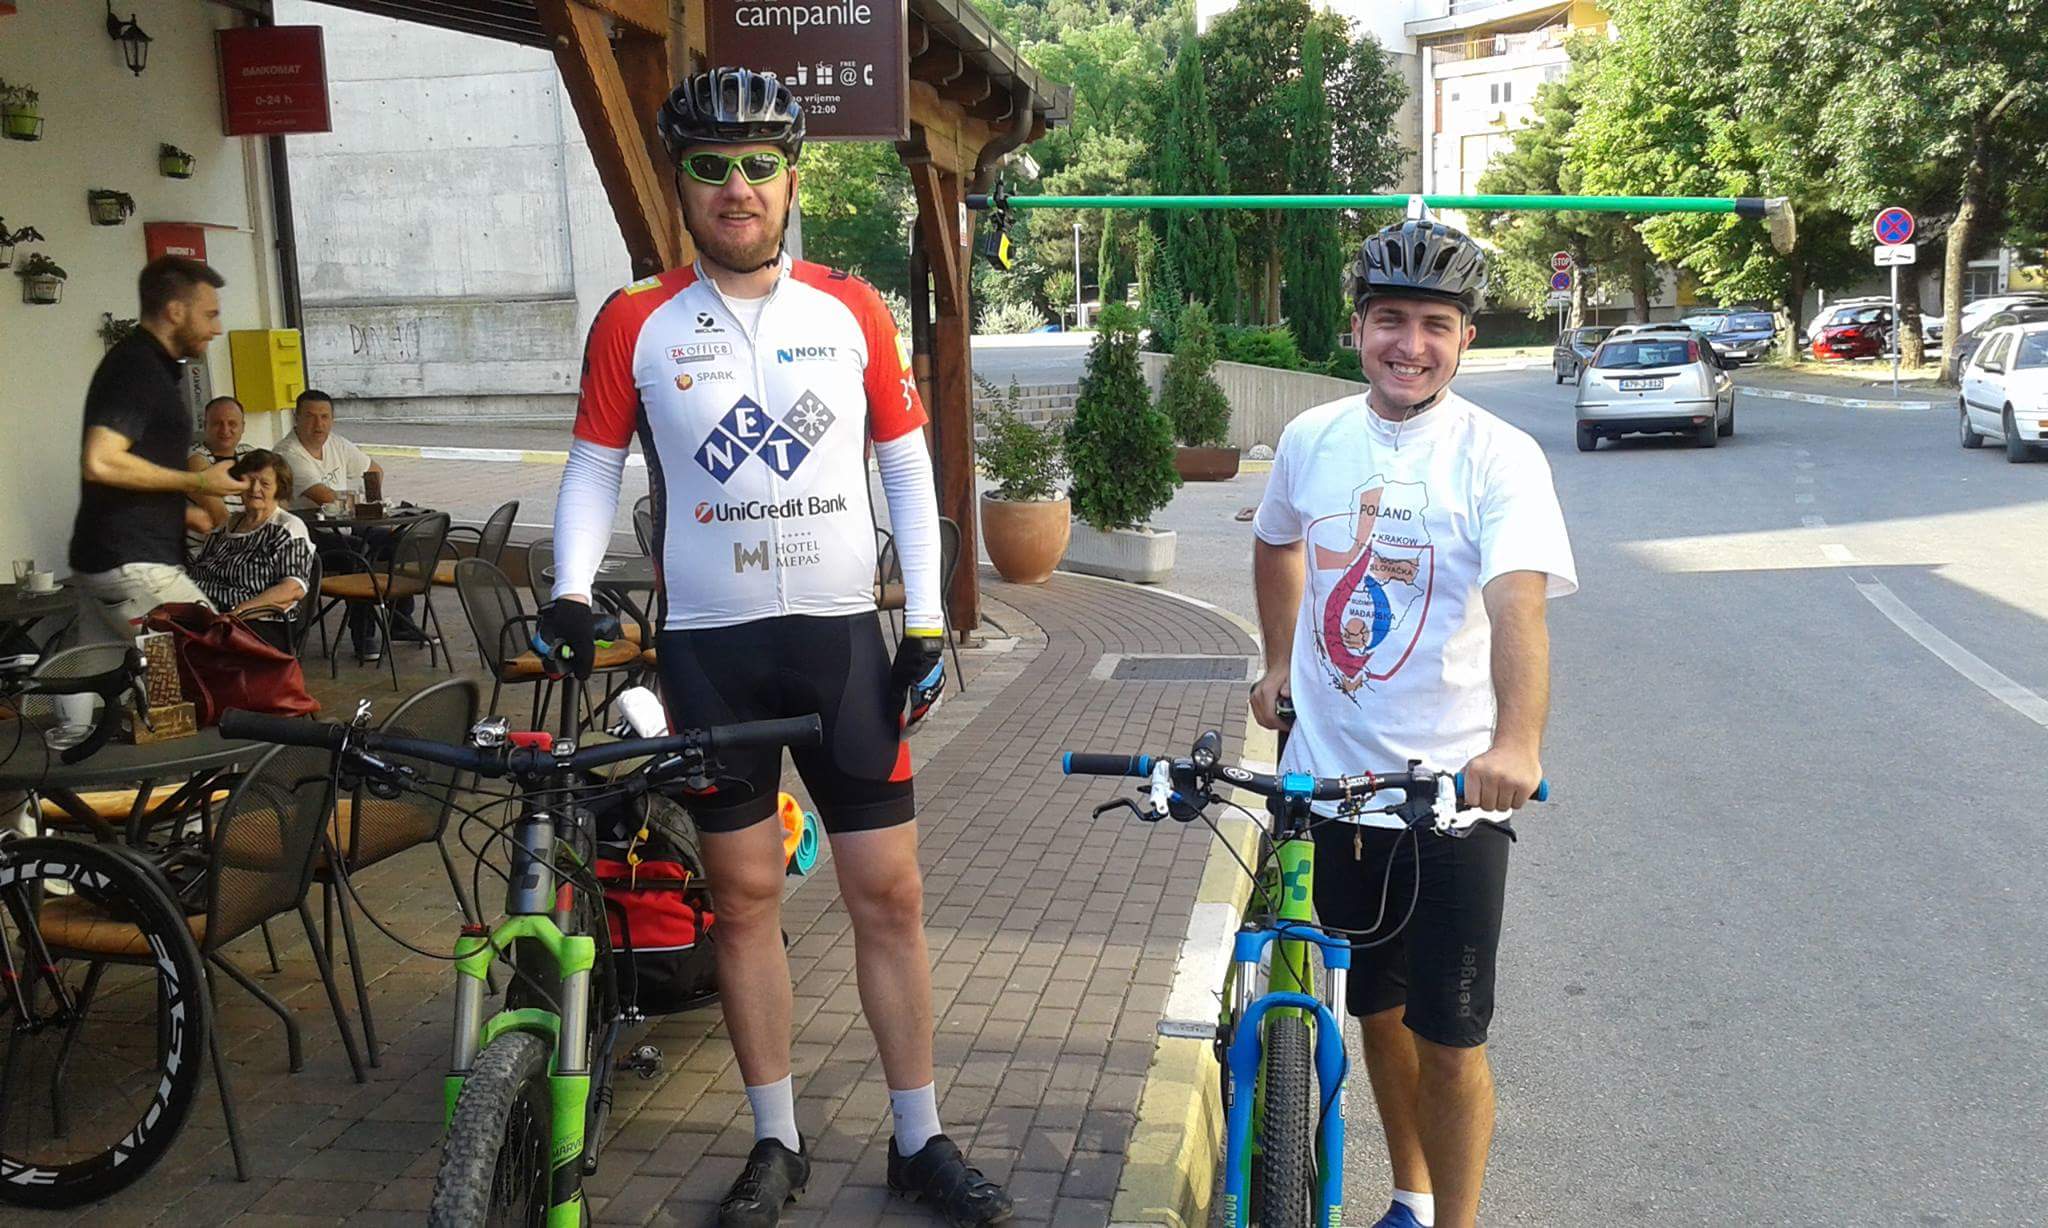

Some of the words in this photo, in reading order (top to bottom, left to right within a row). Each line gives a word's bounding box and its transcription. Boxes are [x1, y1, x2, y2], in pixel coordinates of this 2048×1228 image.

[735, 0, 872, 35] campanile
[241, 64, 302, 77] BANKOMAT
[255, 95, 281, 105] 0-24
[804, 93, 841, 104] vrijeme
[811, 104, 837, 114] 22:00
[795, 346, 837, 358] NOKT
[696, 371, 734, 382] SPARK
[716, 499, 804, 522] UniCredit
[808, 493, 848, 516] Bank
[1360, 504, 1412, 521] POLAND
[1378, 533, 1418, 546] KRAKOW
[775, 540, 821, 555] HOTEL
[775, 553, 821, 568] MEPAS
